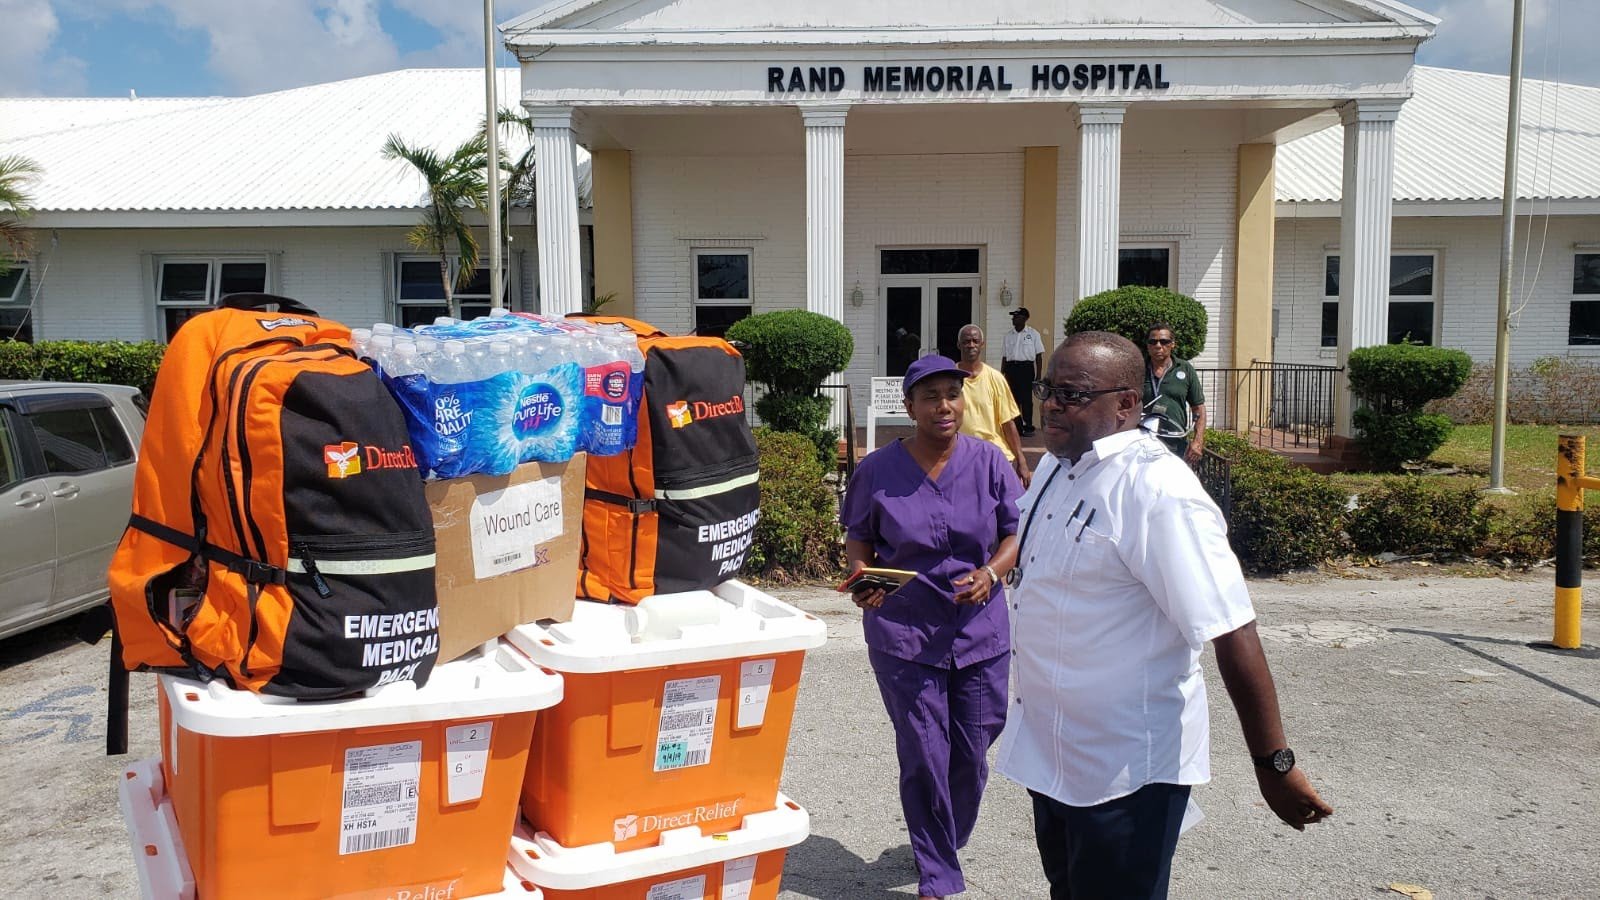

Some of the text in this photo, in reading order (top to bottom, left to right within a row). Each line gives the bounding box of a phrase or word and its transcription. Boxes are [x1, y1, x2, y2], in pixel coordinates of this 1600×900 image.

[768, 63, 1170, 92] RAND MEMORIAL HOSPITAL
[538, 403, 562, 421] Life
[484, 501, 560, 537] Wound Care
[344, 606, 440, 639] EMERGEN
[362, 633, 439, 668] MEDICAL
[372, 660, 422, 689] PACK
[469, 729, 477, 740] 2
[455, 762, 463, 774] 6
[407, 787, 415, 798] E
[343, 820, 378, 832] XH HSTA
[642, 799, 742, 833] Direct Relief
